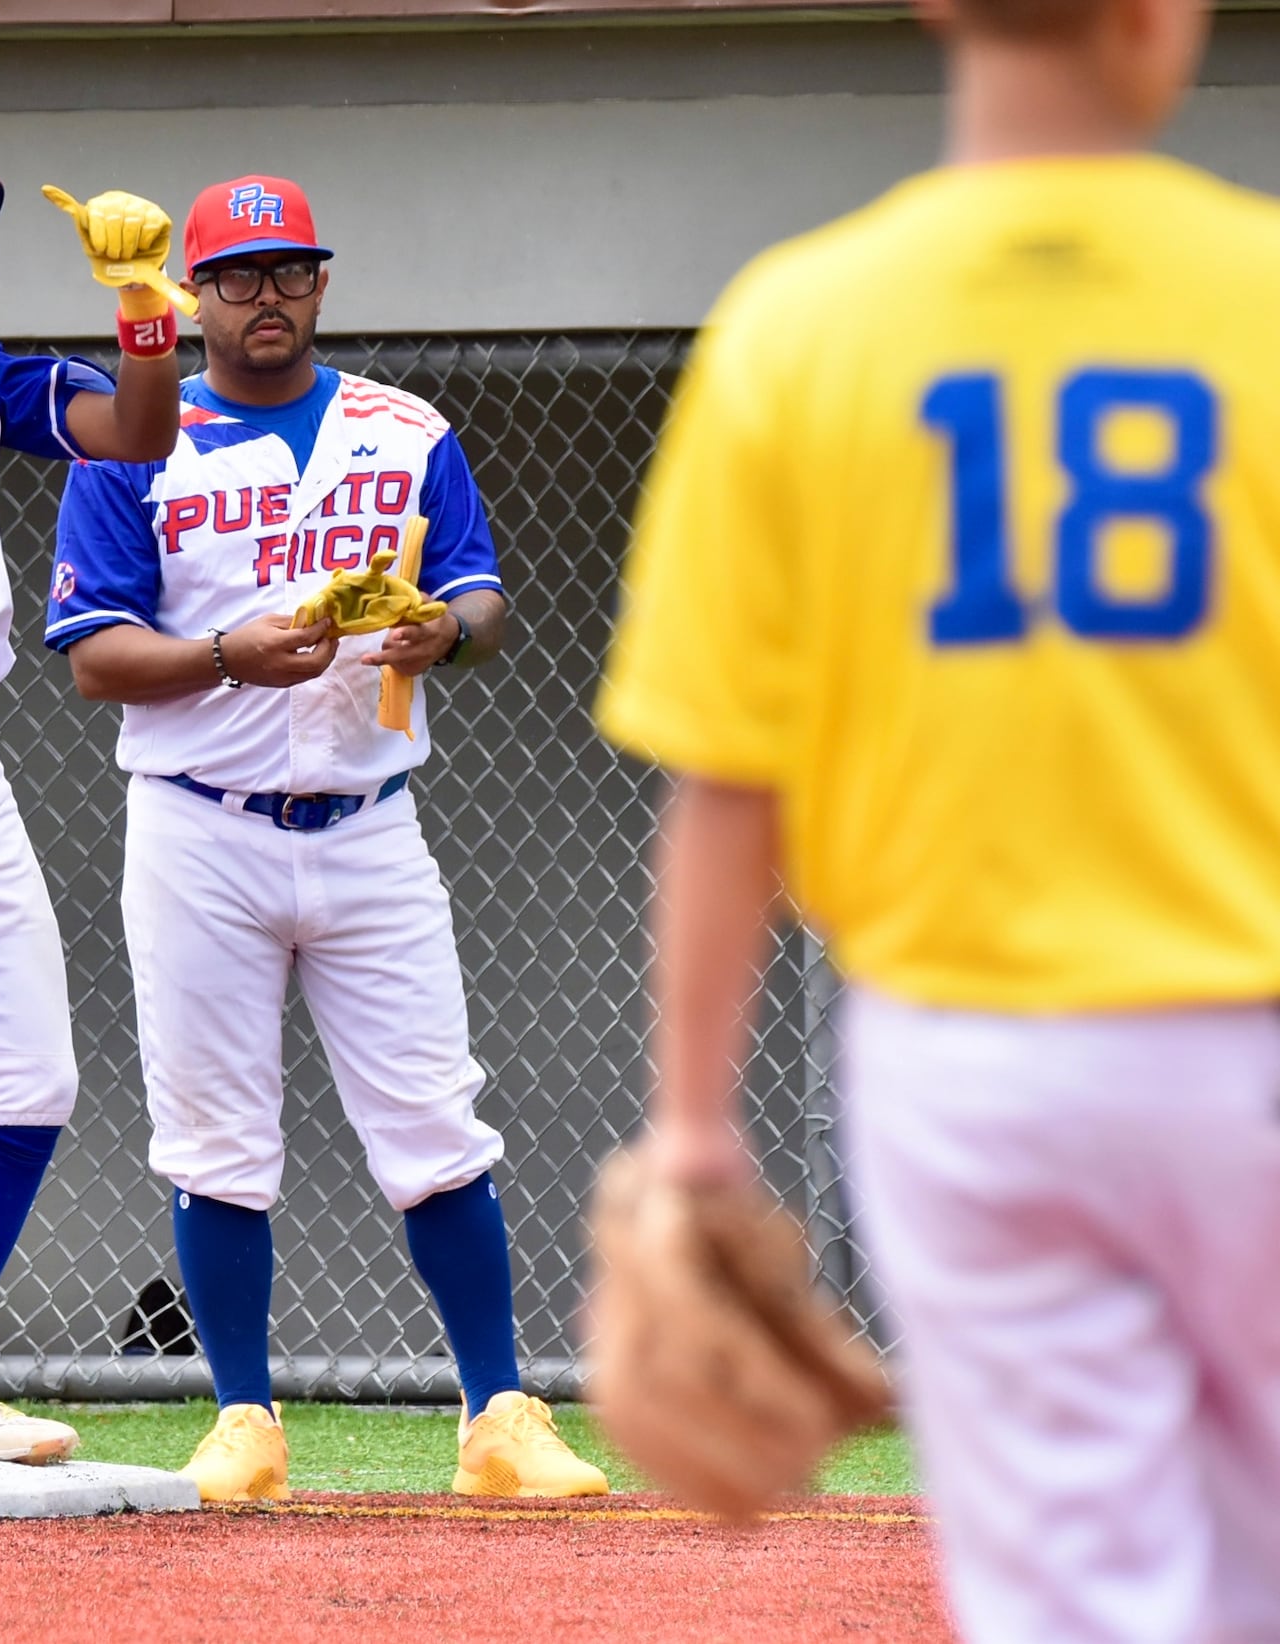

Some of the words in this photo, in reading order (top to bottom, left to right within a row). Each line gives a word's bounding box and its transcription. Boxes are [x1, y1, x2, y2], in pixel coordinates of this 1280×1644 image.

[229, 183, 285, 227] PR
[133, 317, 166, 347] 12
[919, 366, 1219, 647] 18
